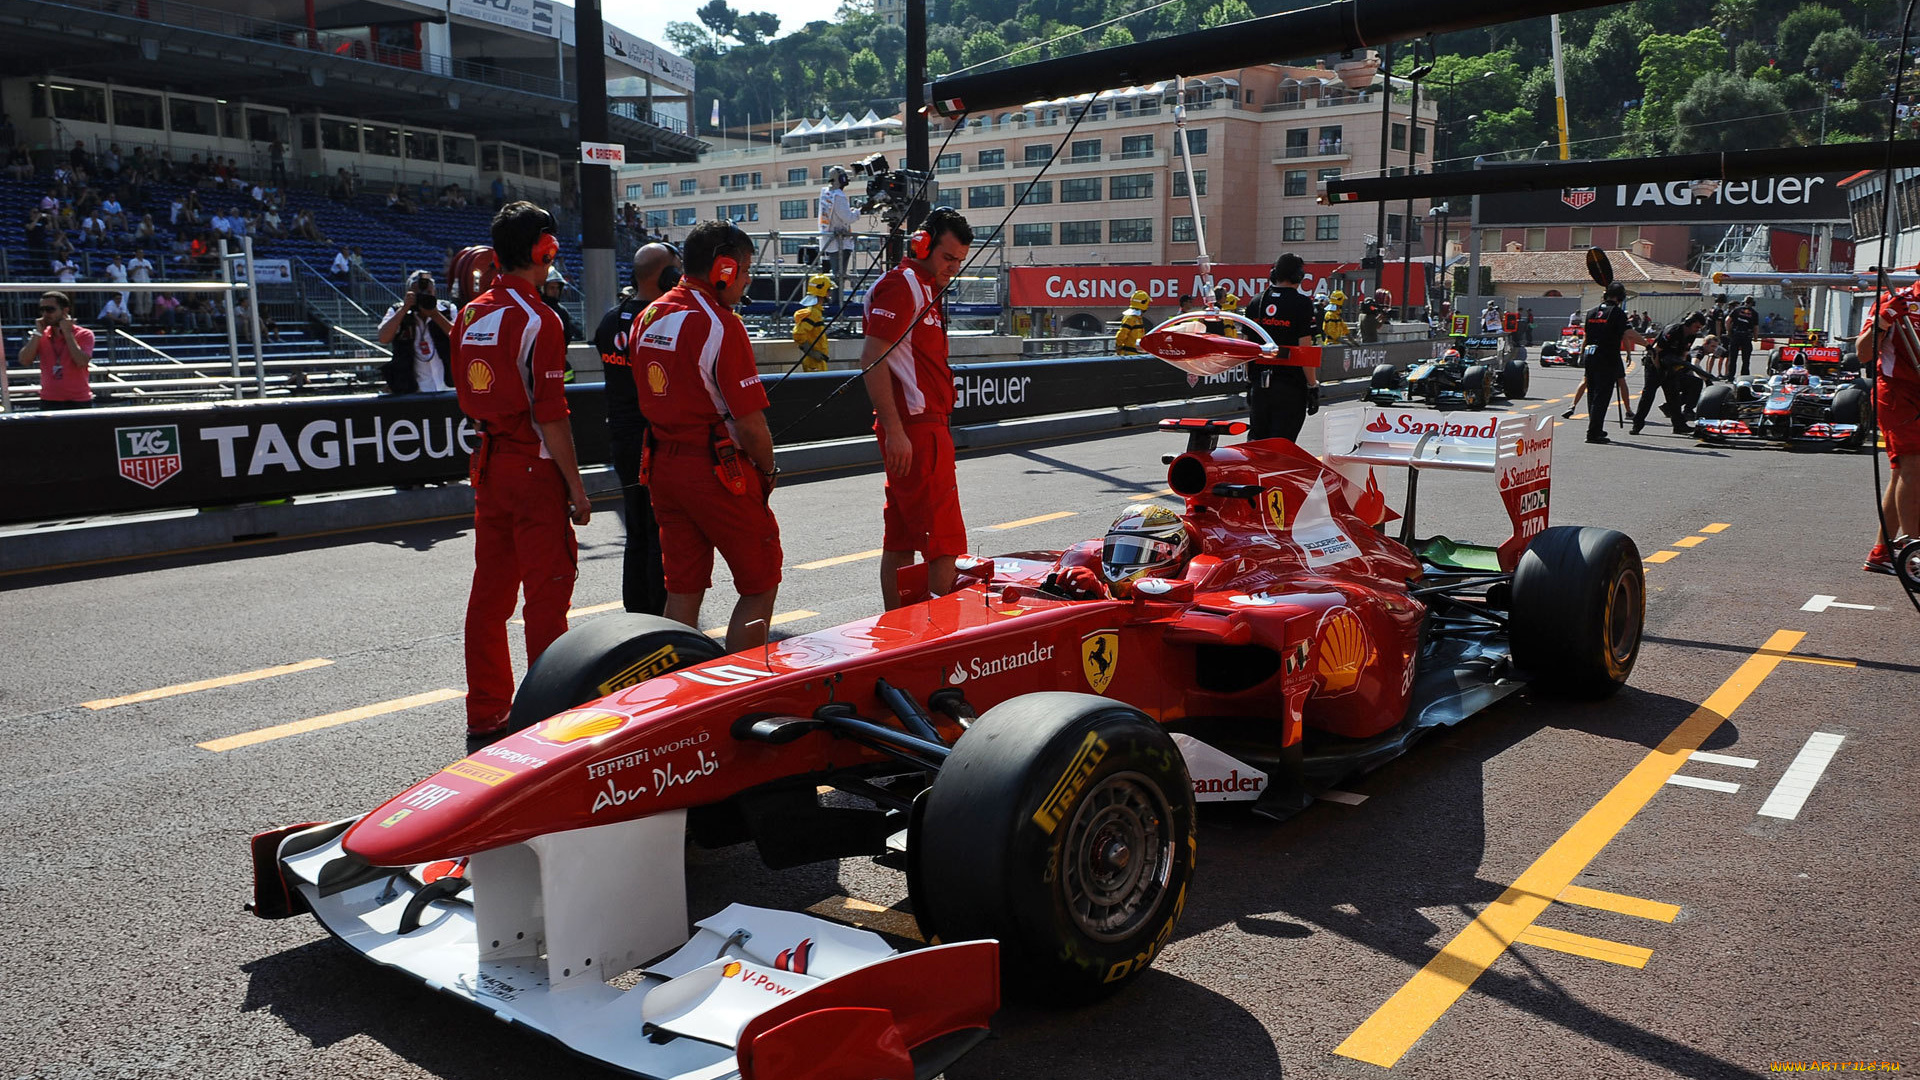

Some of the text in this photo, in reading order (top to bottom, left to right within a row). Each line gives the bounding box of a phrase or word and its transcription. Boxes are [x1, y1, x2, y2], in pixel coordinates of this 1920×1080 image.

[595, 148, 622, 161] BRIEFING
[1045, 275, 1137, 298] CASINO
[1150, 279, 1179, 298] DE
[1191, 273, 1273, 298] MONT
[953, 375, 1031, 408] GHeuer
[1394, 414, 1498, 439] Santand
[126, 430, 170, 455] TAG
[200, 416, 477, 478] TAGHeue
[1524, 438, 1552, 455] V-Power
[124, 458, 177, 484] HEUER
[1510, 459, 1550, 488] Santander
[1520, 491, 1540, 513] AMD
[1522, 515, 1546, 539] TATA
[1304, 537, 1338, 550] SCUDERIA
[1323, 543, 1352, 555] FERRARI
[970, 640, 1055, 681] Santander
[675, 664, 781, 687] 5
[586, 731, 710, 781] Ferrari WORLD
[451, 762, 506, 783] PIRELLI
[591, 749, 720, 815] Abu Dhabi
[1032, 730, 1110, 835] PIRELLI
[1190, 770, 1264, 793] tander
[400, 783, 461, 811] FIAT
[742, 968, 797, 997] V-Pow
